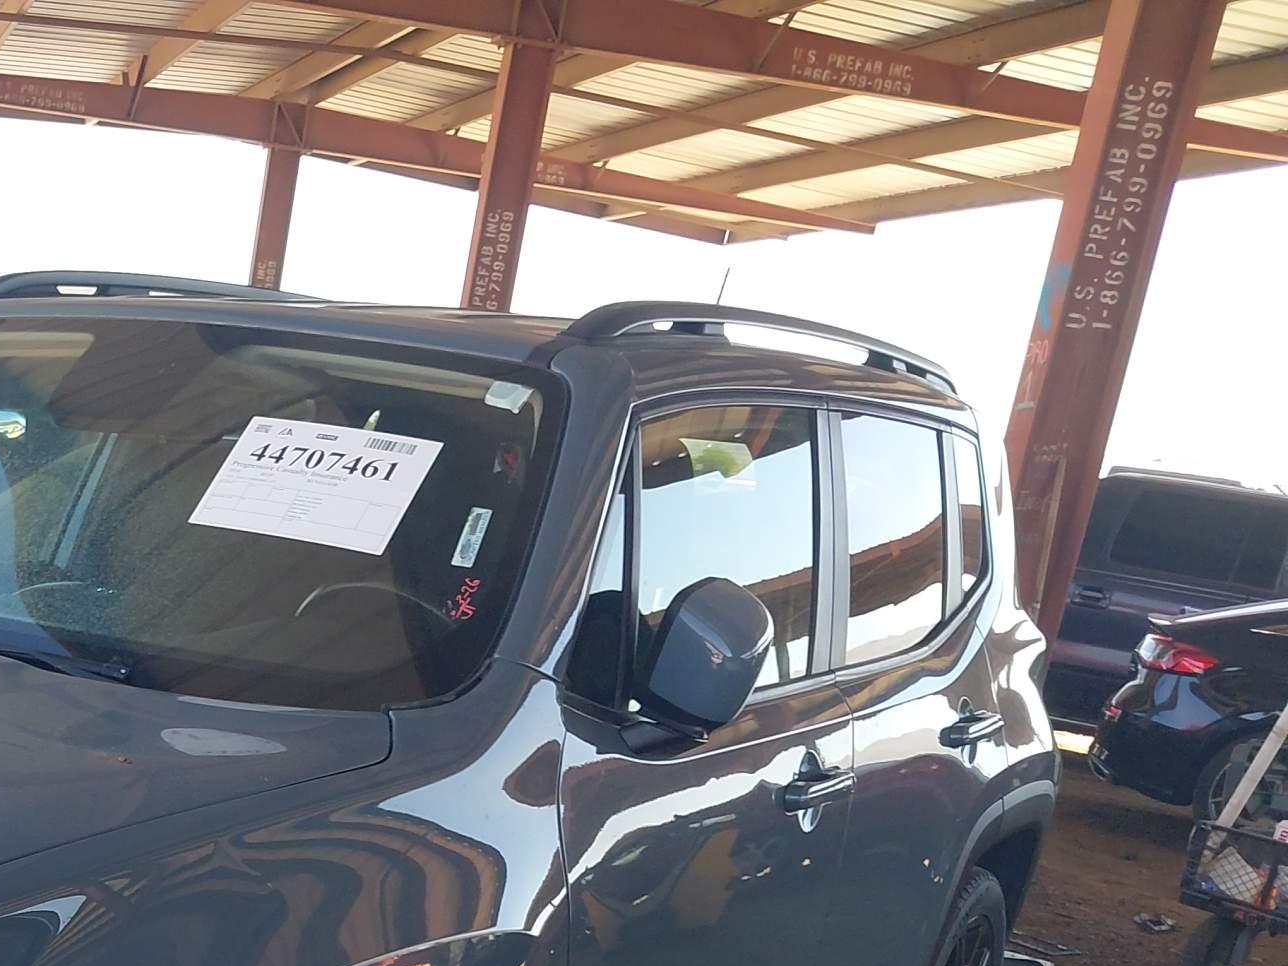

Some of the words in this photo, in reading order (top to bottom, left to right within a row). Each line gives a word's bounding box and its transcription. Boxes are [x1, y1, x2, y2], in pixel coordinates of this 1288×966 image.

[827, 52, 883, 75] PREFAB
[1065, 278, 1098, 329] U.S.
[1084, 147, 1130, 259] PREFAB
[1116, 76, 1150, 131] INC.
[1092, 80, 1173, 329] 1-866-799-0969
[472, 246, 494, 306] PREFAB
[249, 443, 400, 482] 44707461
